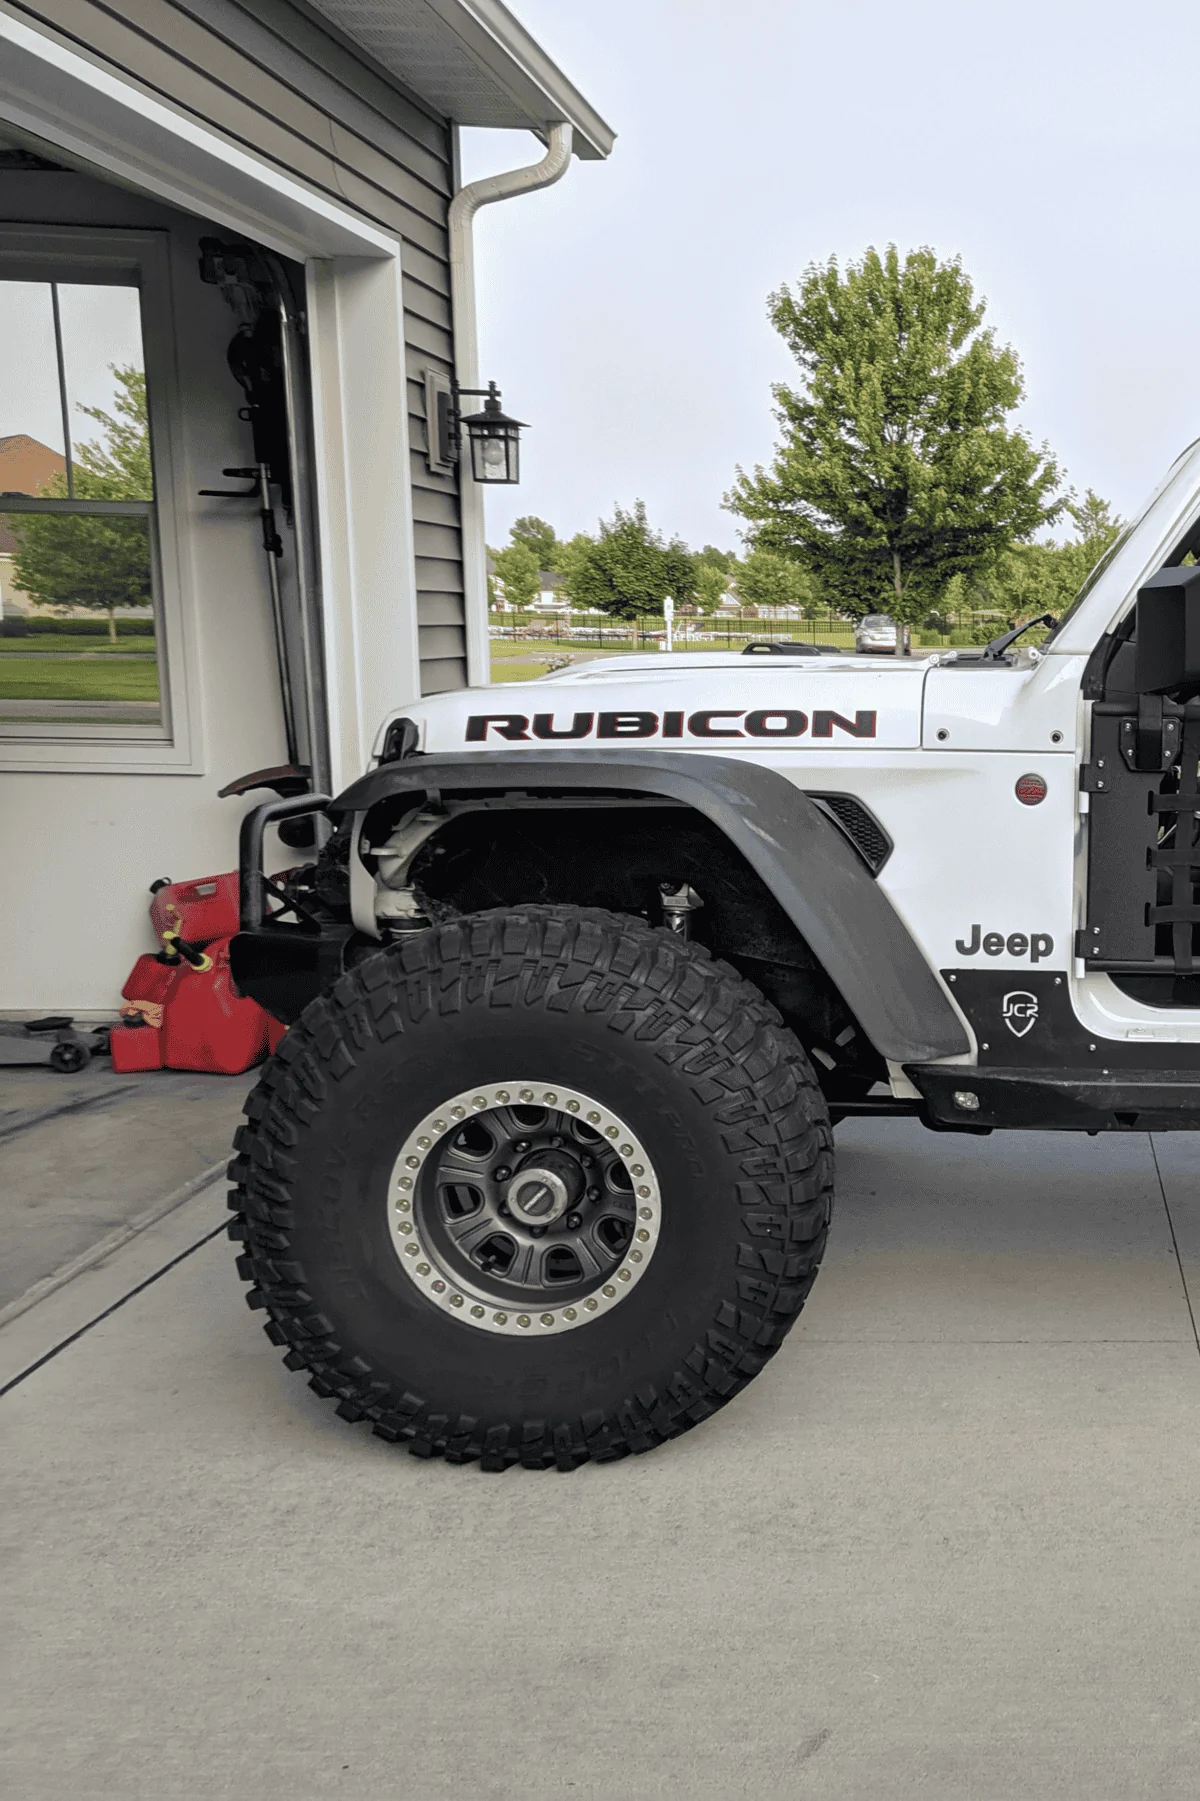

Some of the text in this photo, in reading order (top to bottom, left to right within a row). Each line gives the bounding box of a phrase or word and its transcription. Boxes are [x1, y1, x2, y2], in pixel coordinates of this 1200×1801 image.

[465, 710, 877, 742] RUBICON
[955, 924, 1054, 963] Jeep
[1002, 1003, 1039, 1018] JCR
